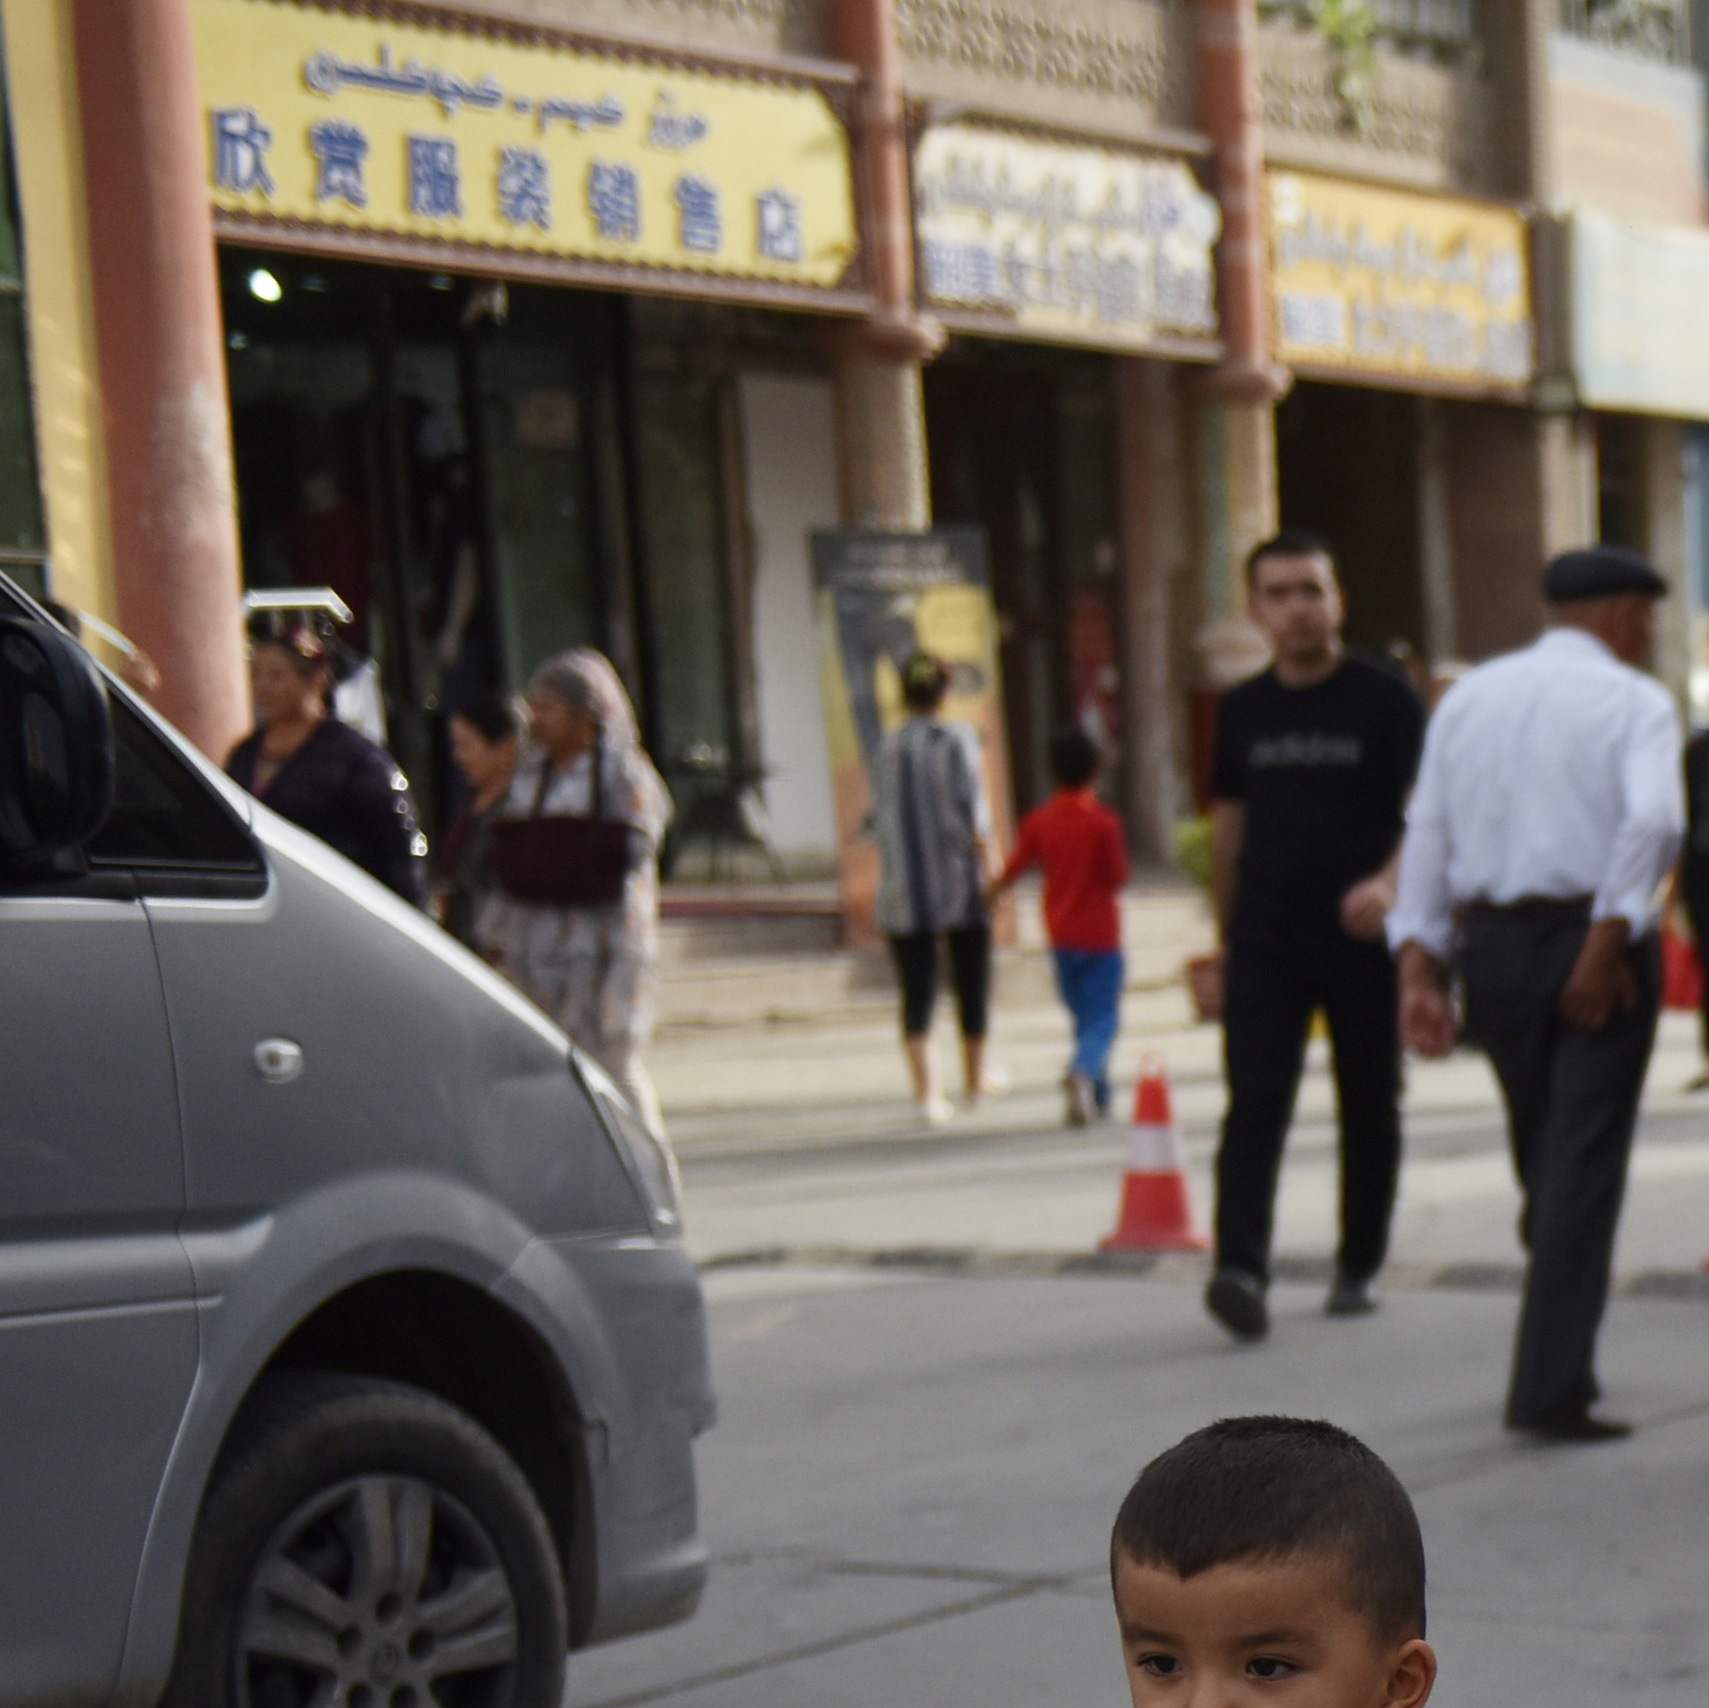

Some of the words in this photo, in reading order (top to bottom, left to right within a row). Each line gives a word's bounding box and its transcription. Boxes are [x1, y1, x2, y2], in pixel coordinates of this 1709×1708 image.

[214, 108, 803, 263] 欣赏服装销售店
